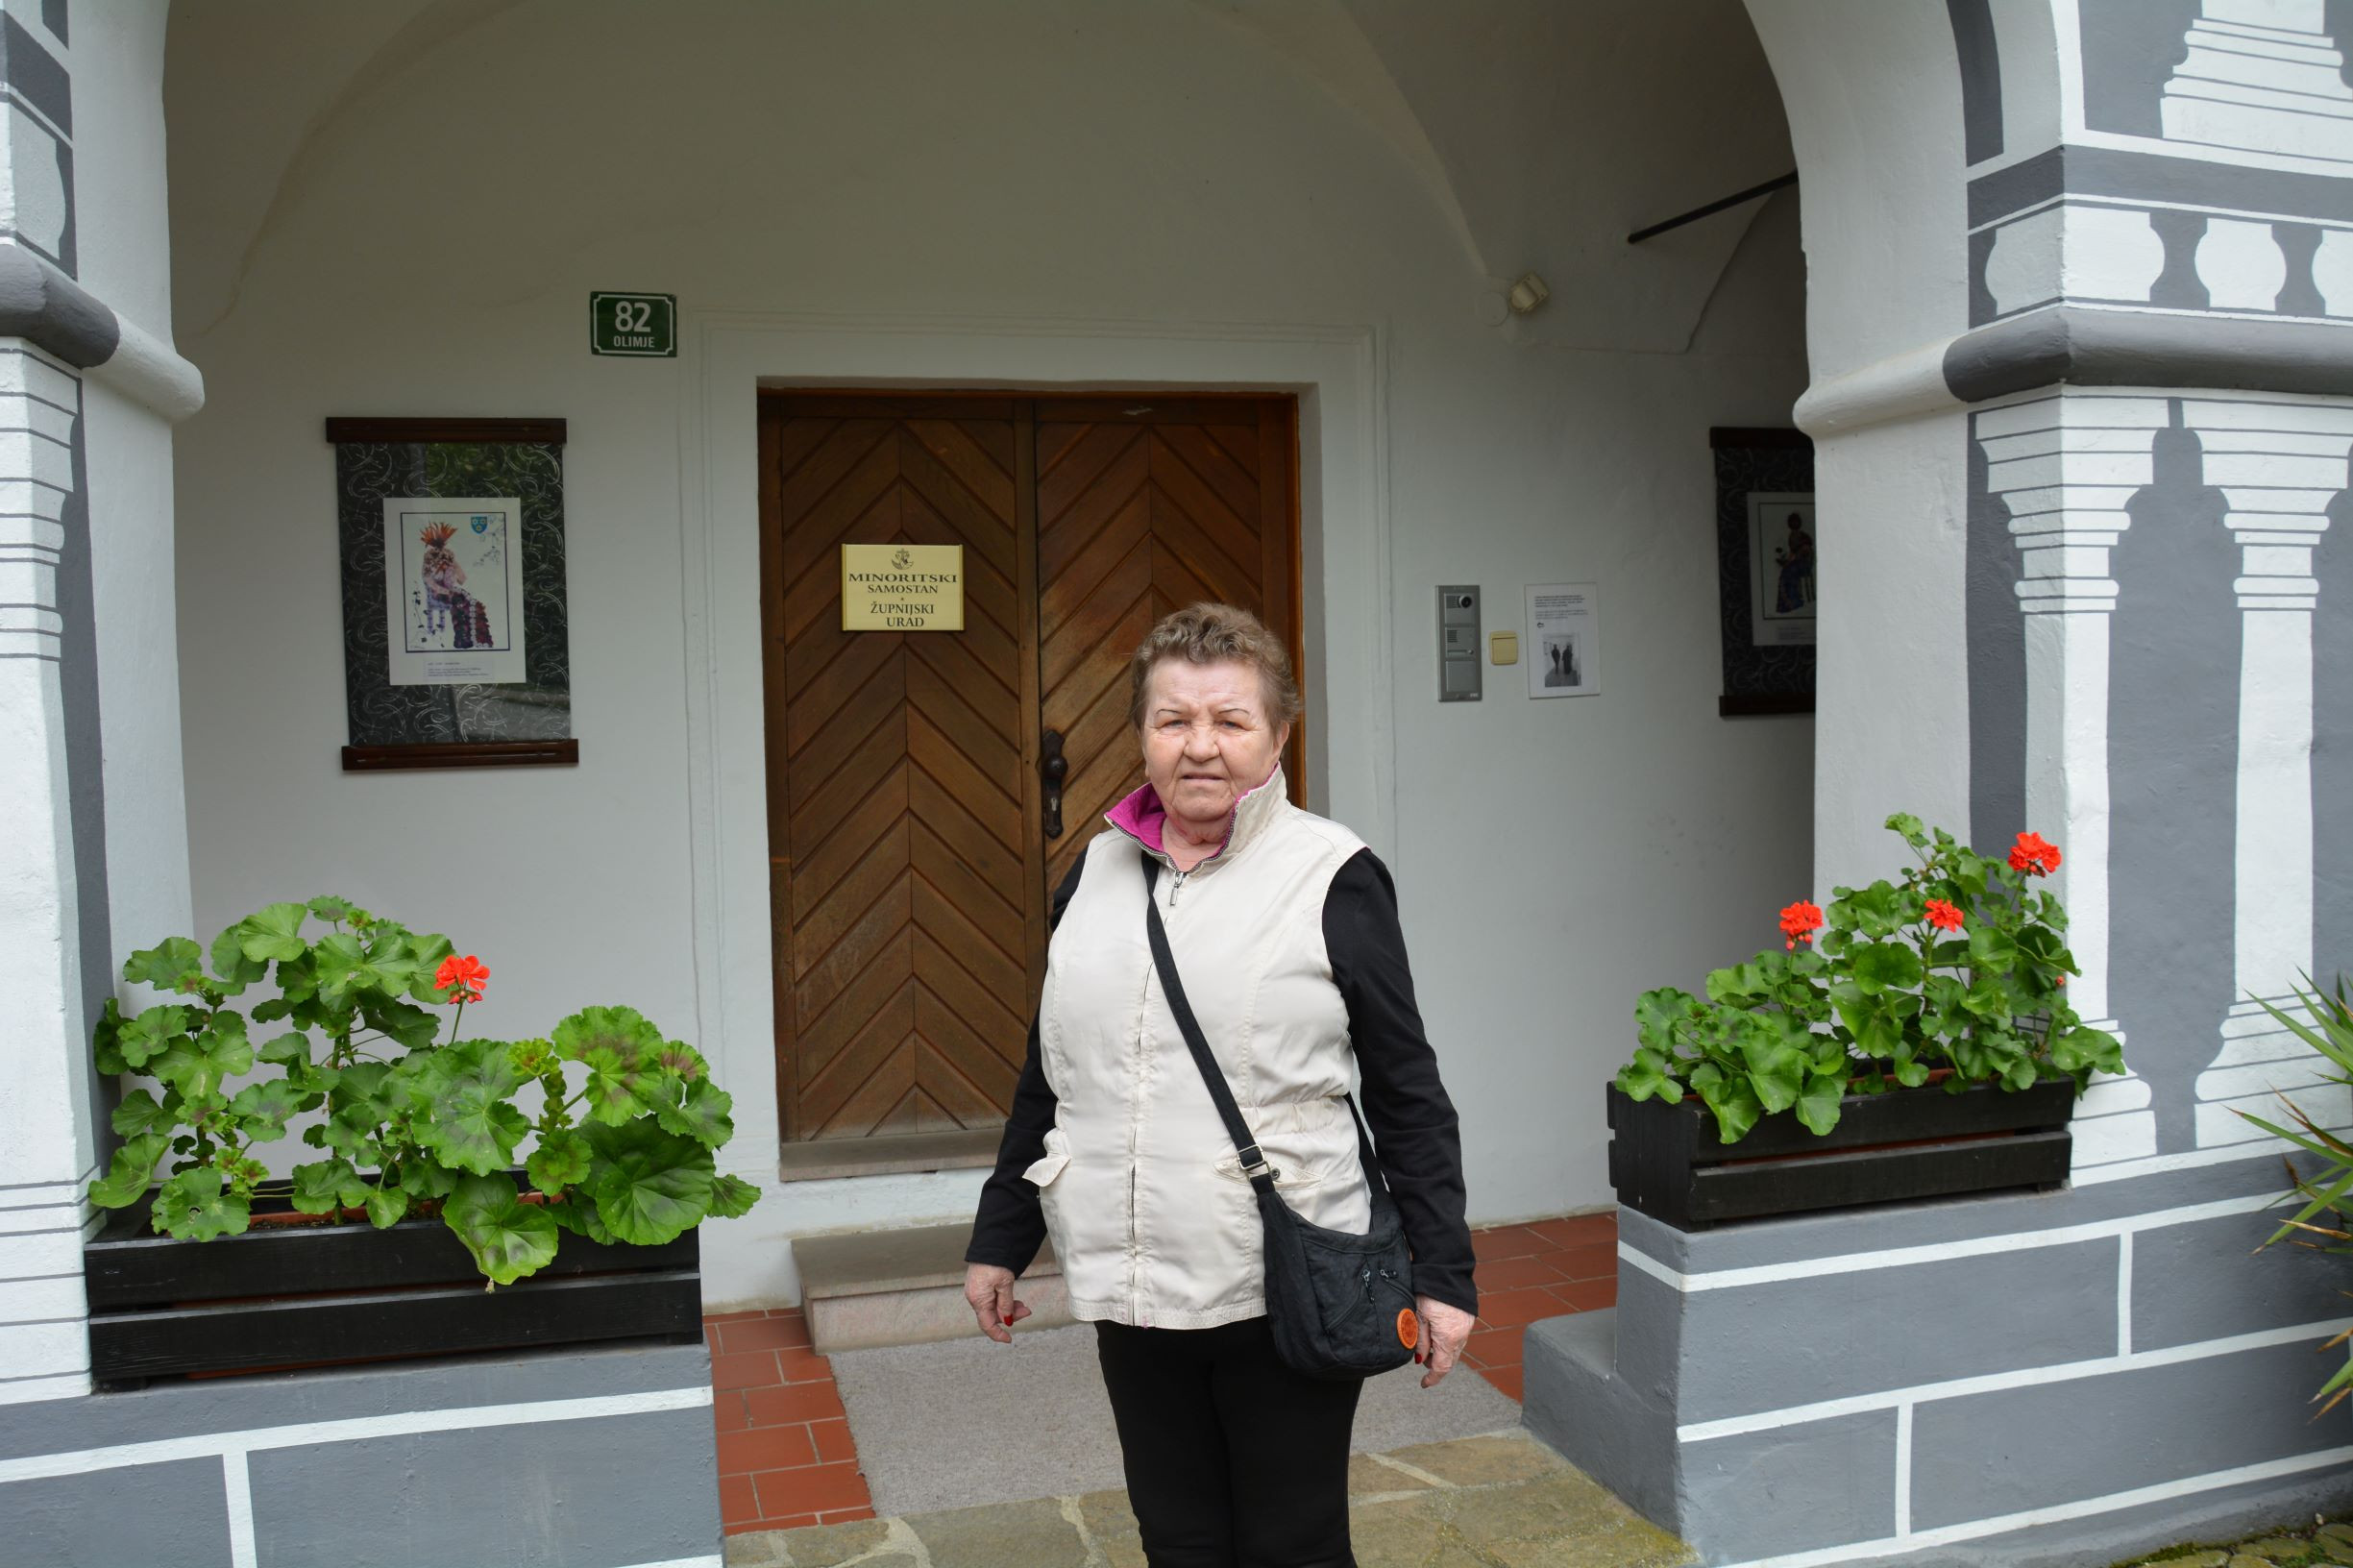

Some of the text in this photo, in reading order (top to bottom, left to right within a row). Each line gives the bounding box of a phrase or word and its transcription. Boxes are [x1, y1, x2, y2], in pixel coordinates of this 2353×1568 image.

[615, 300, 651, 332] 82
[613, 335, 655, 348] OLIMJE
[848, 573, 957, 583] MINORITSKI
[868, 584, 939, 594] SAMOSTAN
[870, 600, 934, 615] ŽUPNIJSKI
[886, 617, 924, 627] URAD
